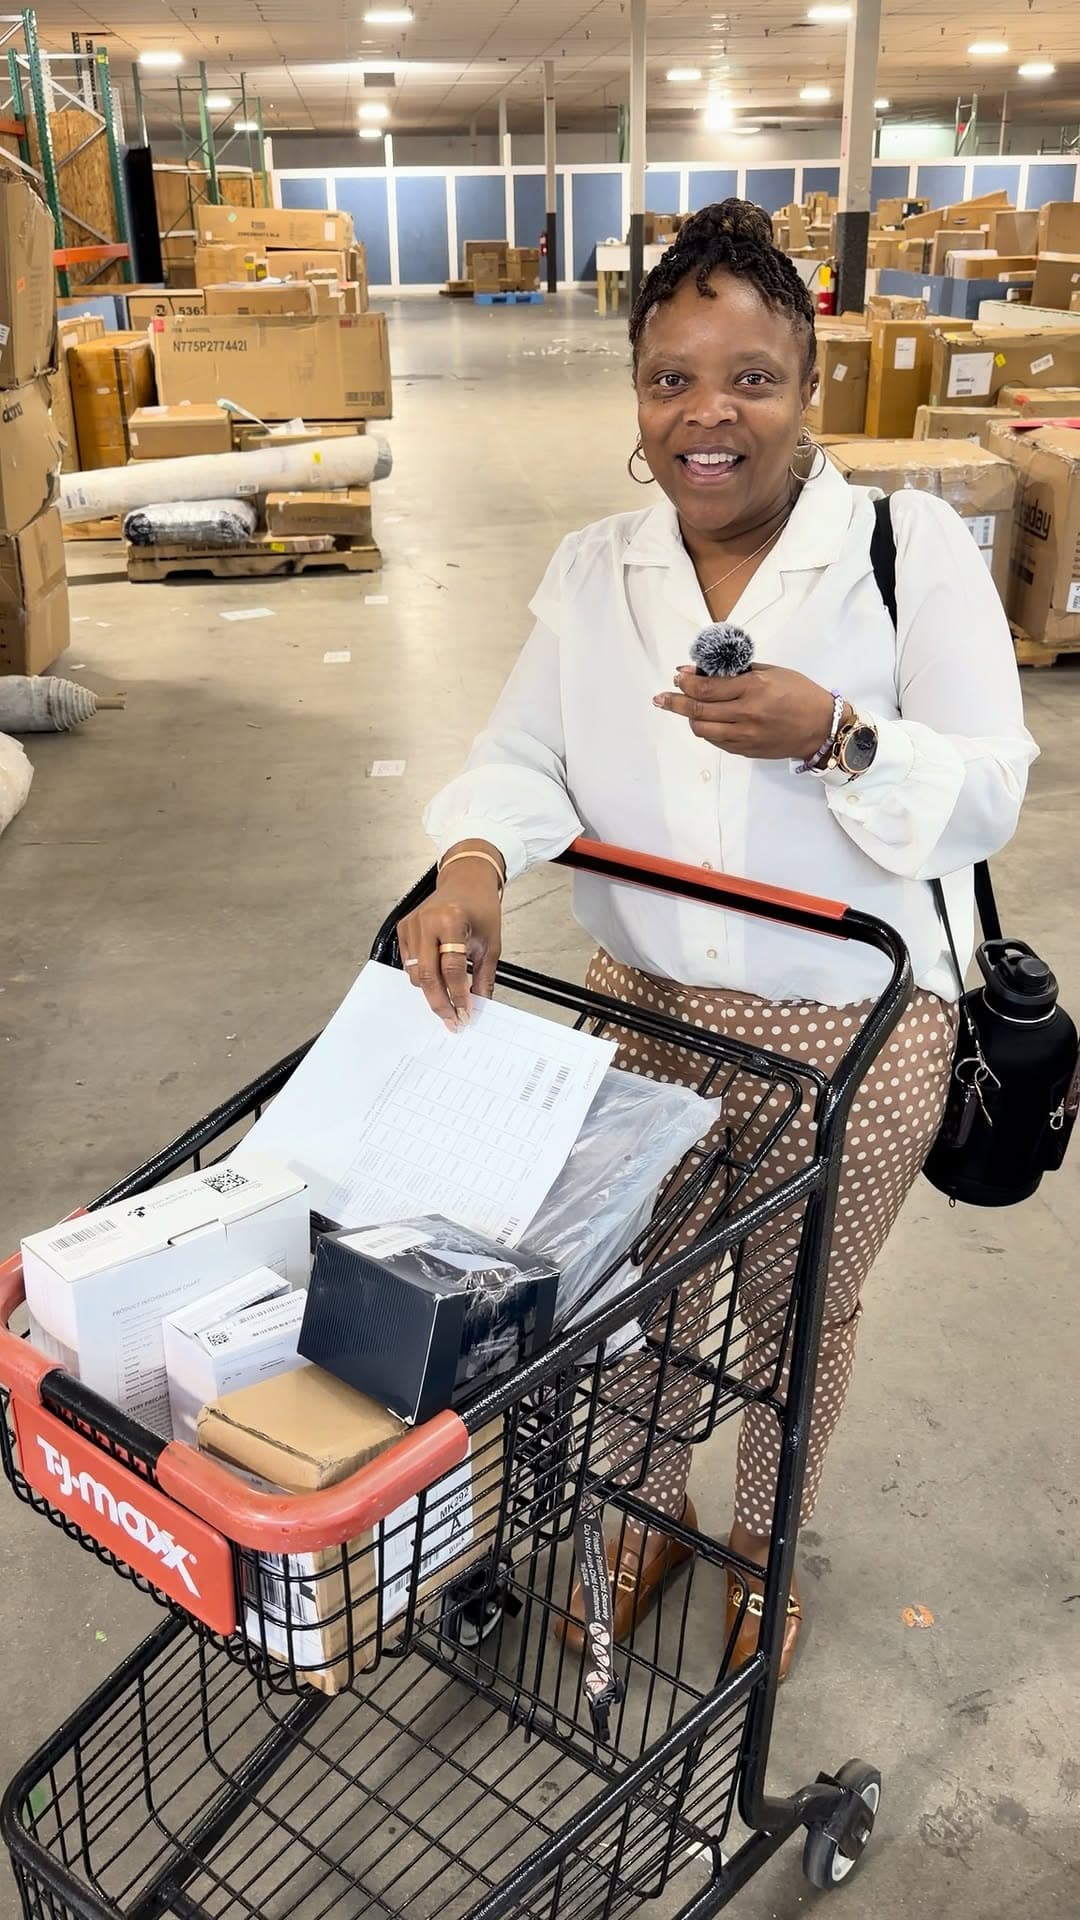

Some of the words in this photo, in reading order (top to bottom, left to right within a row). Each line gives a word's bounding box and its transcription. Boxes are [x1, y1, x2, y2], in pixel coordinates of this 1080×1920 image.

[440, 1487, 470, 1520] MK292
[450, 1514, 462, 1537] A
[584, 1523, 591, 1535] Do
[592, 1531, 601, 1554] Please
[586, 1550, 594, 1568] Leave
[589, 1569, 598, 1584] Child
[598, 1575, 607, 1591] Child
[592, 1585, 602, 1620] Unattended
[601, 1592, 610, 1620] Securely
